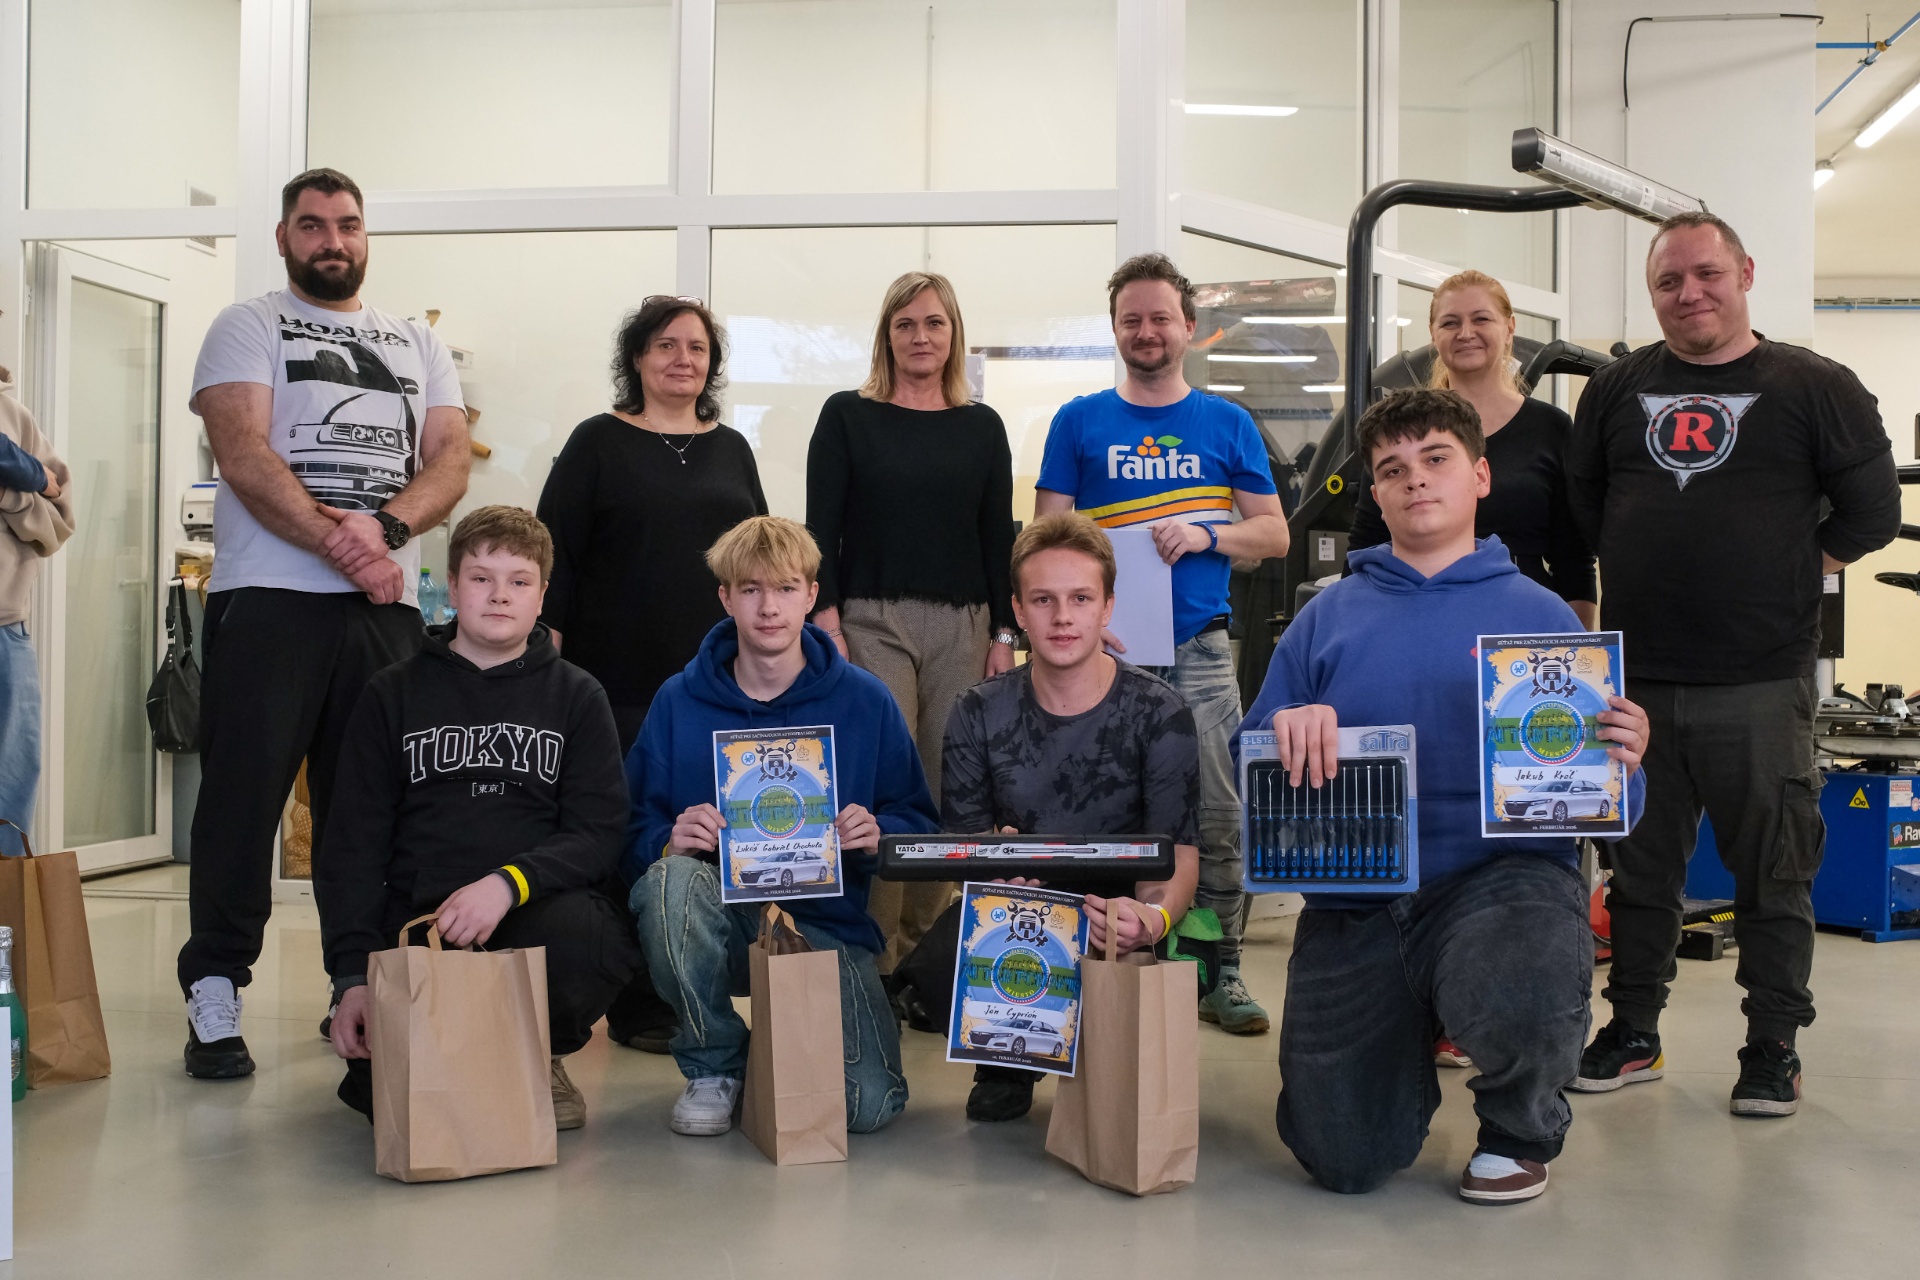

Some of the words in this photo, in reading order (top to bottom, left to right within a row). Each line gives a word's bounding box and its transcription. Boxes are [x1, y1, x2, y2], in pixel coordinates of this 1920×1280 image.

[279, 314, 409, 343] HONDA
[1669, 412, 1715, 451] R
[1108, 445, 1200, 480] Fanta
[403, 723, 564, 784] TOKYO
[1538, 746, 1571, 757] MIESTO
[1515, 769, 1544, 781] Jakub
[762, 842, 790, 852] Gabriel
[1005, 986, 1035, 998] MIESTO
[984, 1004, 999, 1016] Ján
